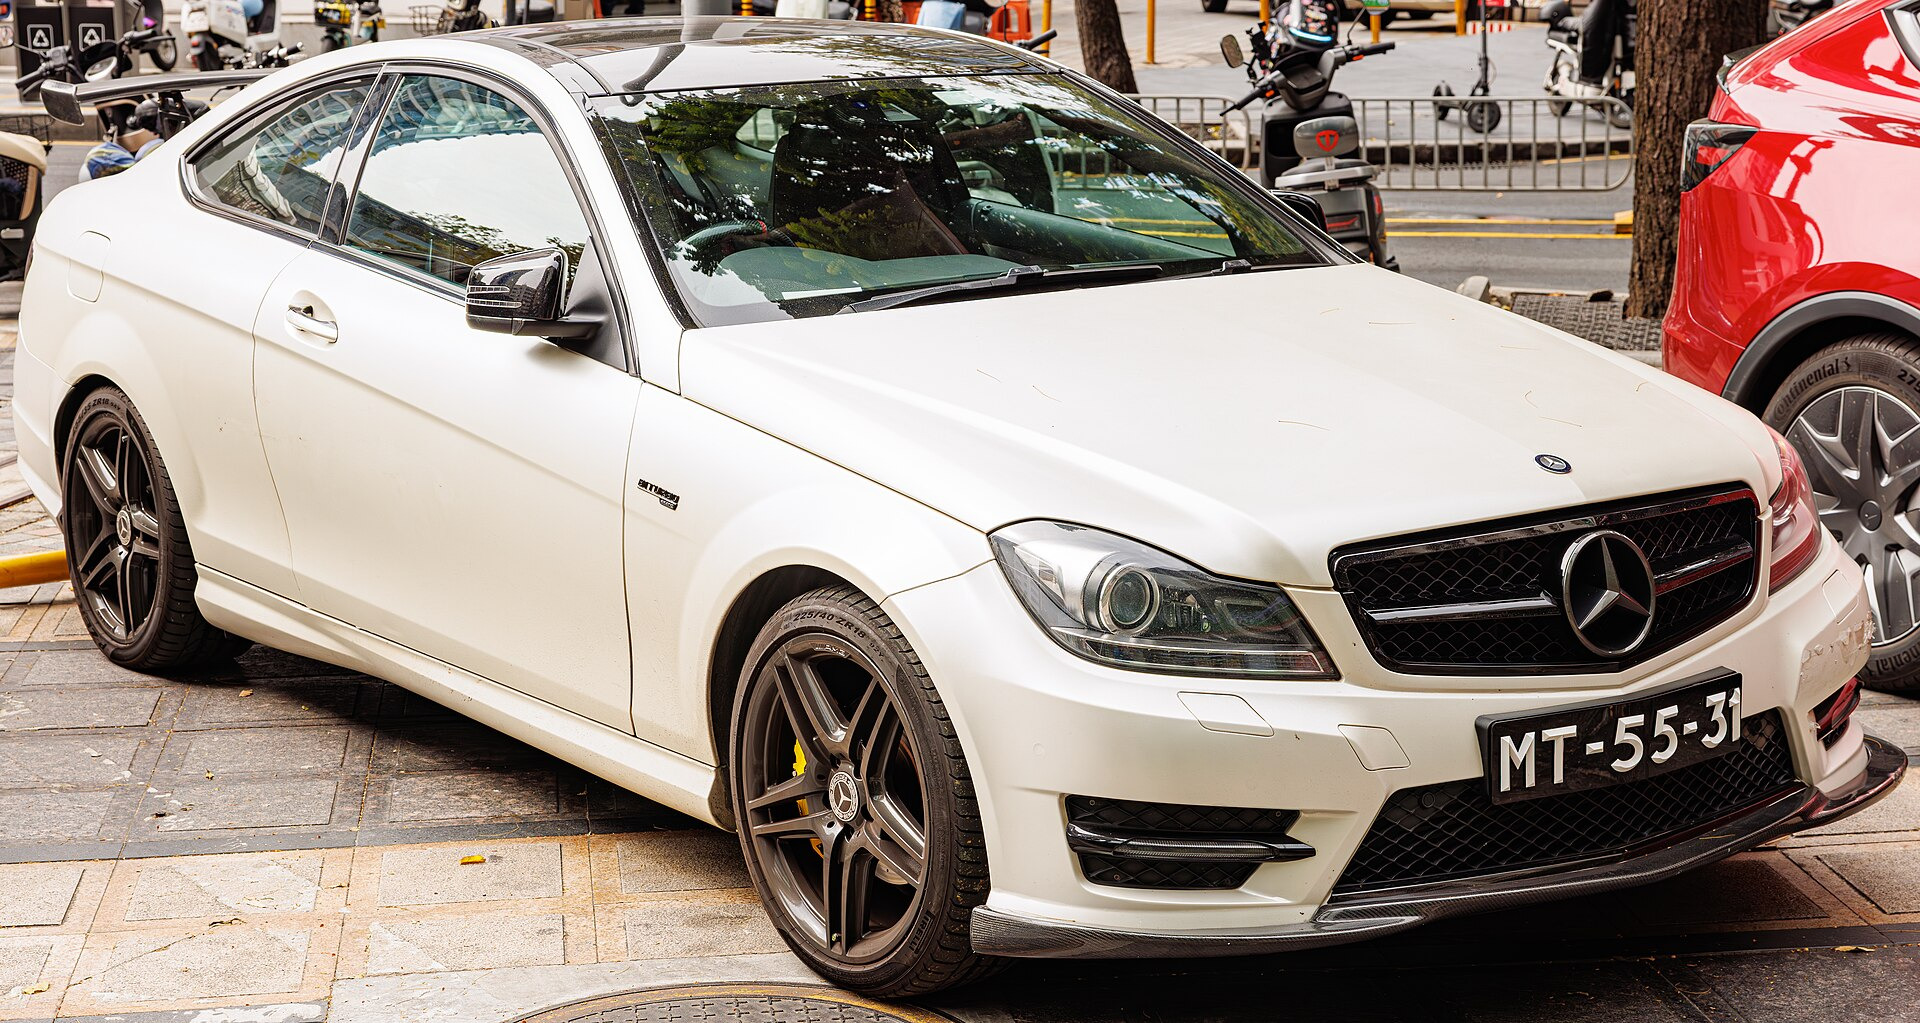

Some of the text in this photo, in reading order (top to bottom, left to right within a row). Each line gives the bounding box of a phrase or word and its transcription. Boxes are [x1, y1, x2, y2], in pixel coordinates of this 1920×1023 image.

[1773, 359, 1840, 421] Continental
[793, 611, 834, 622] 225/40
[835, 617, 867, 639] ZR18
[1500, 687, 1741, 793] MT-55-31
